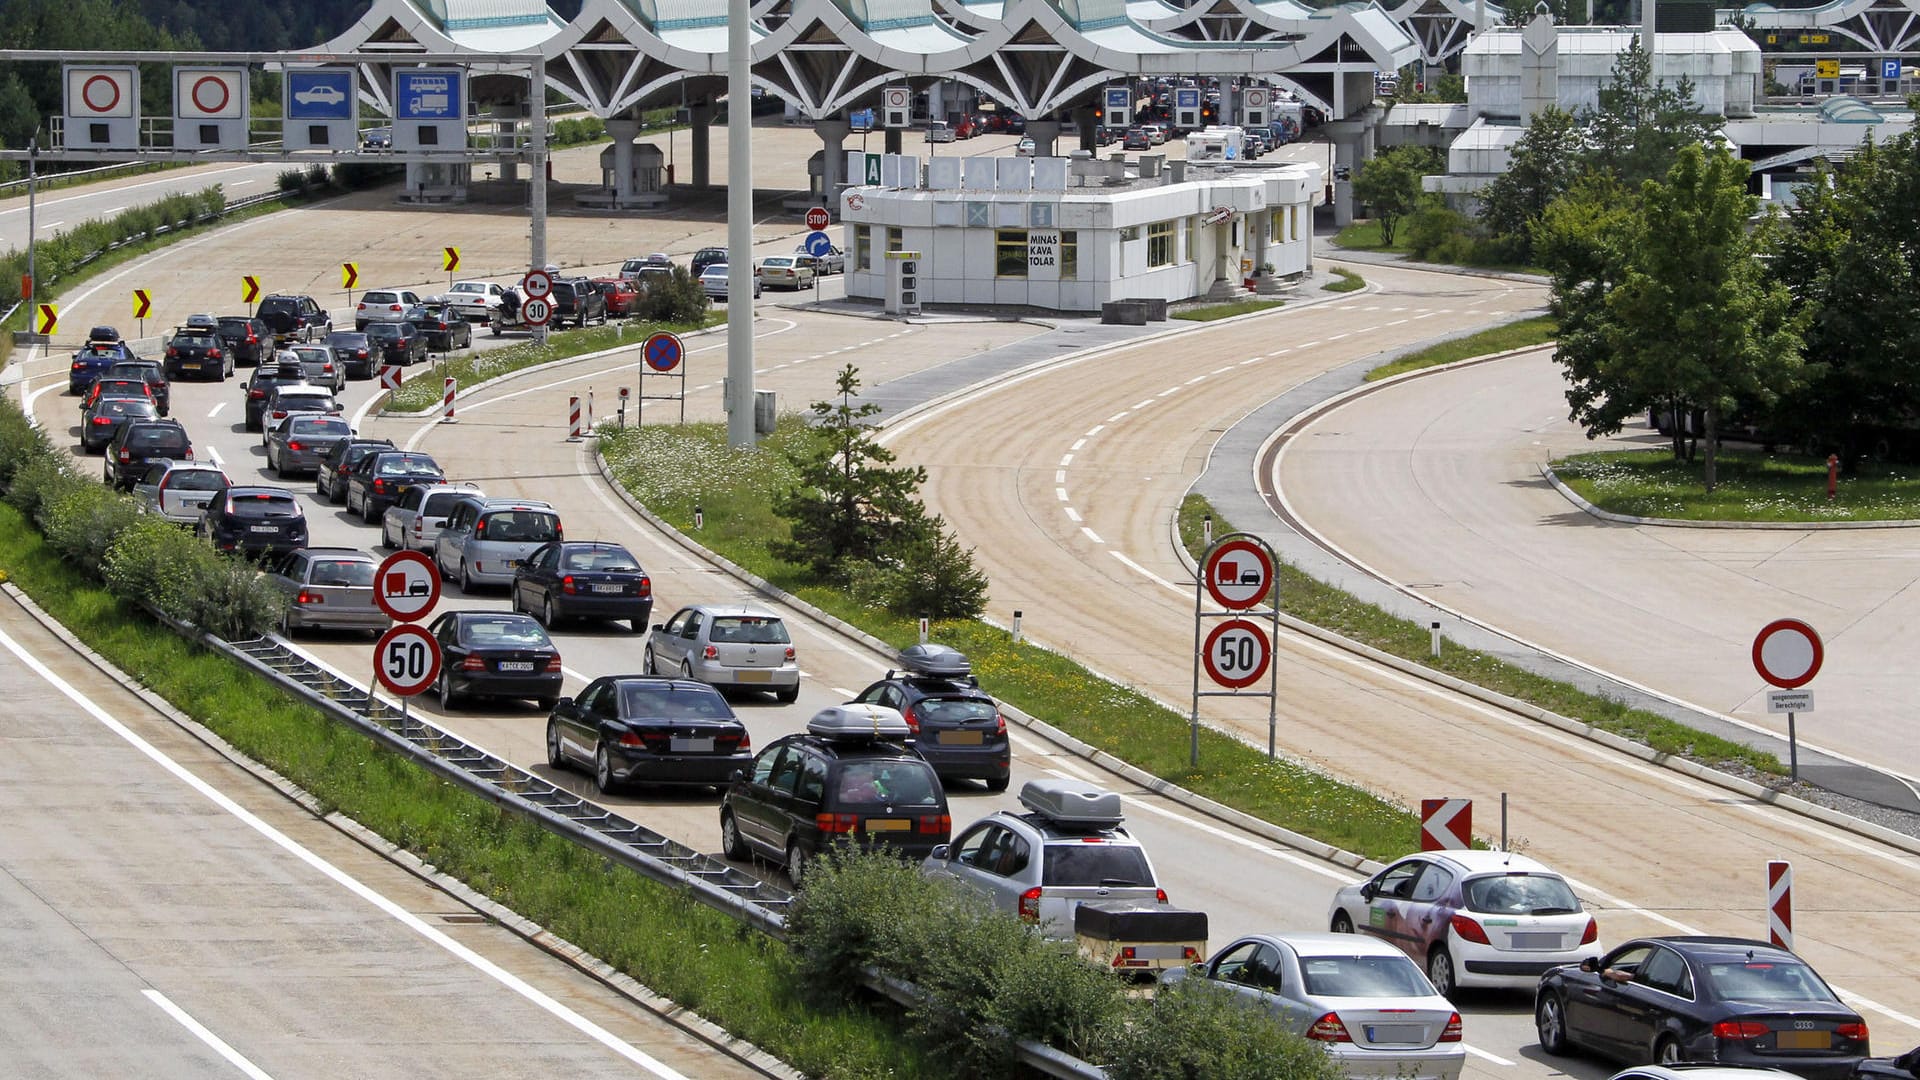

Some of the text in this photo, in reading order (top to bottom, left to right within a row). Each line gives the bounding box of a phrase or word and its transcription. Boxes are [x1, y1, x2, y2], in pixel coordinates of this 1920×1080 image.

[1885, 62, 1897, 76] P
[868, 158, 879, 181] A
[808, 214, 827, 225] STOP
[1030, 235, 1058, 245] MINAS
[1030, 246, 1052, 255] KAVA
[1029, 257, 1055, 266] TOLAR
[529, 303, 544, 319] 30
[389, 641, 425, 679] 50
[1220, 636, 1254, 672] 50
